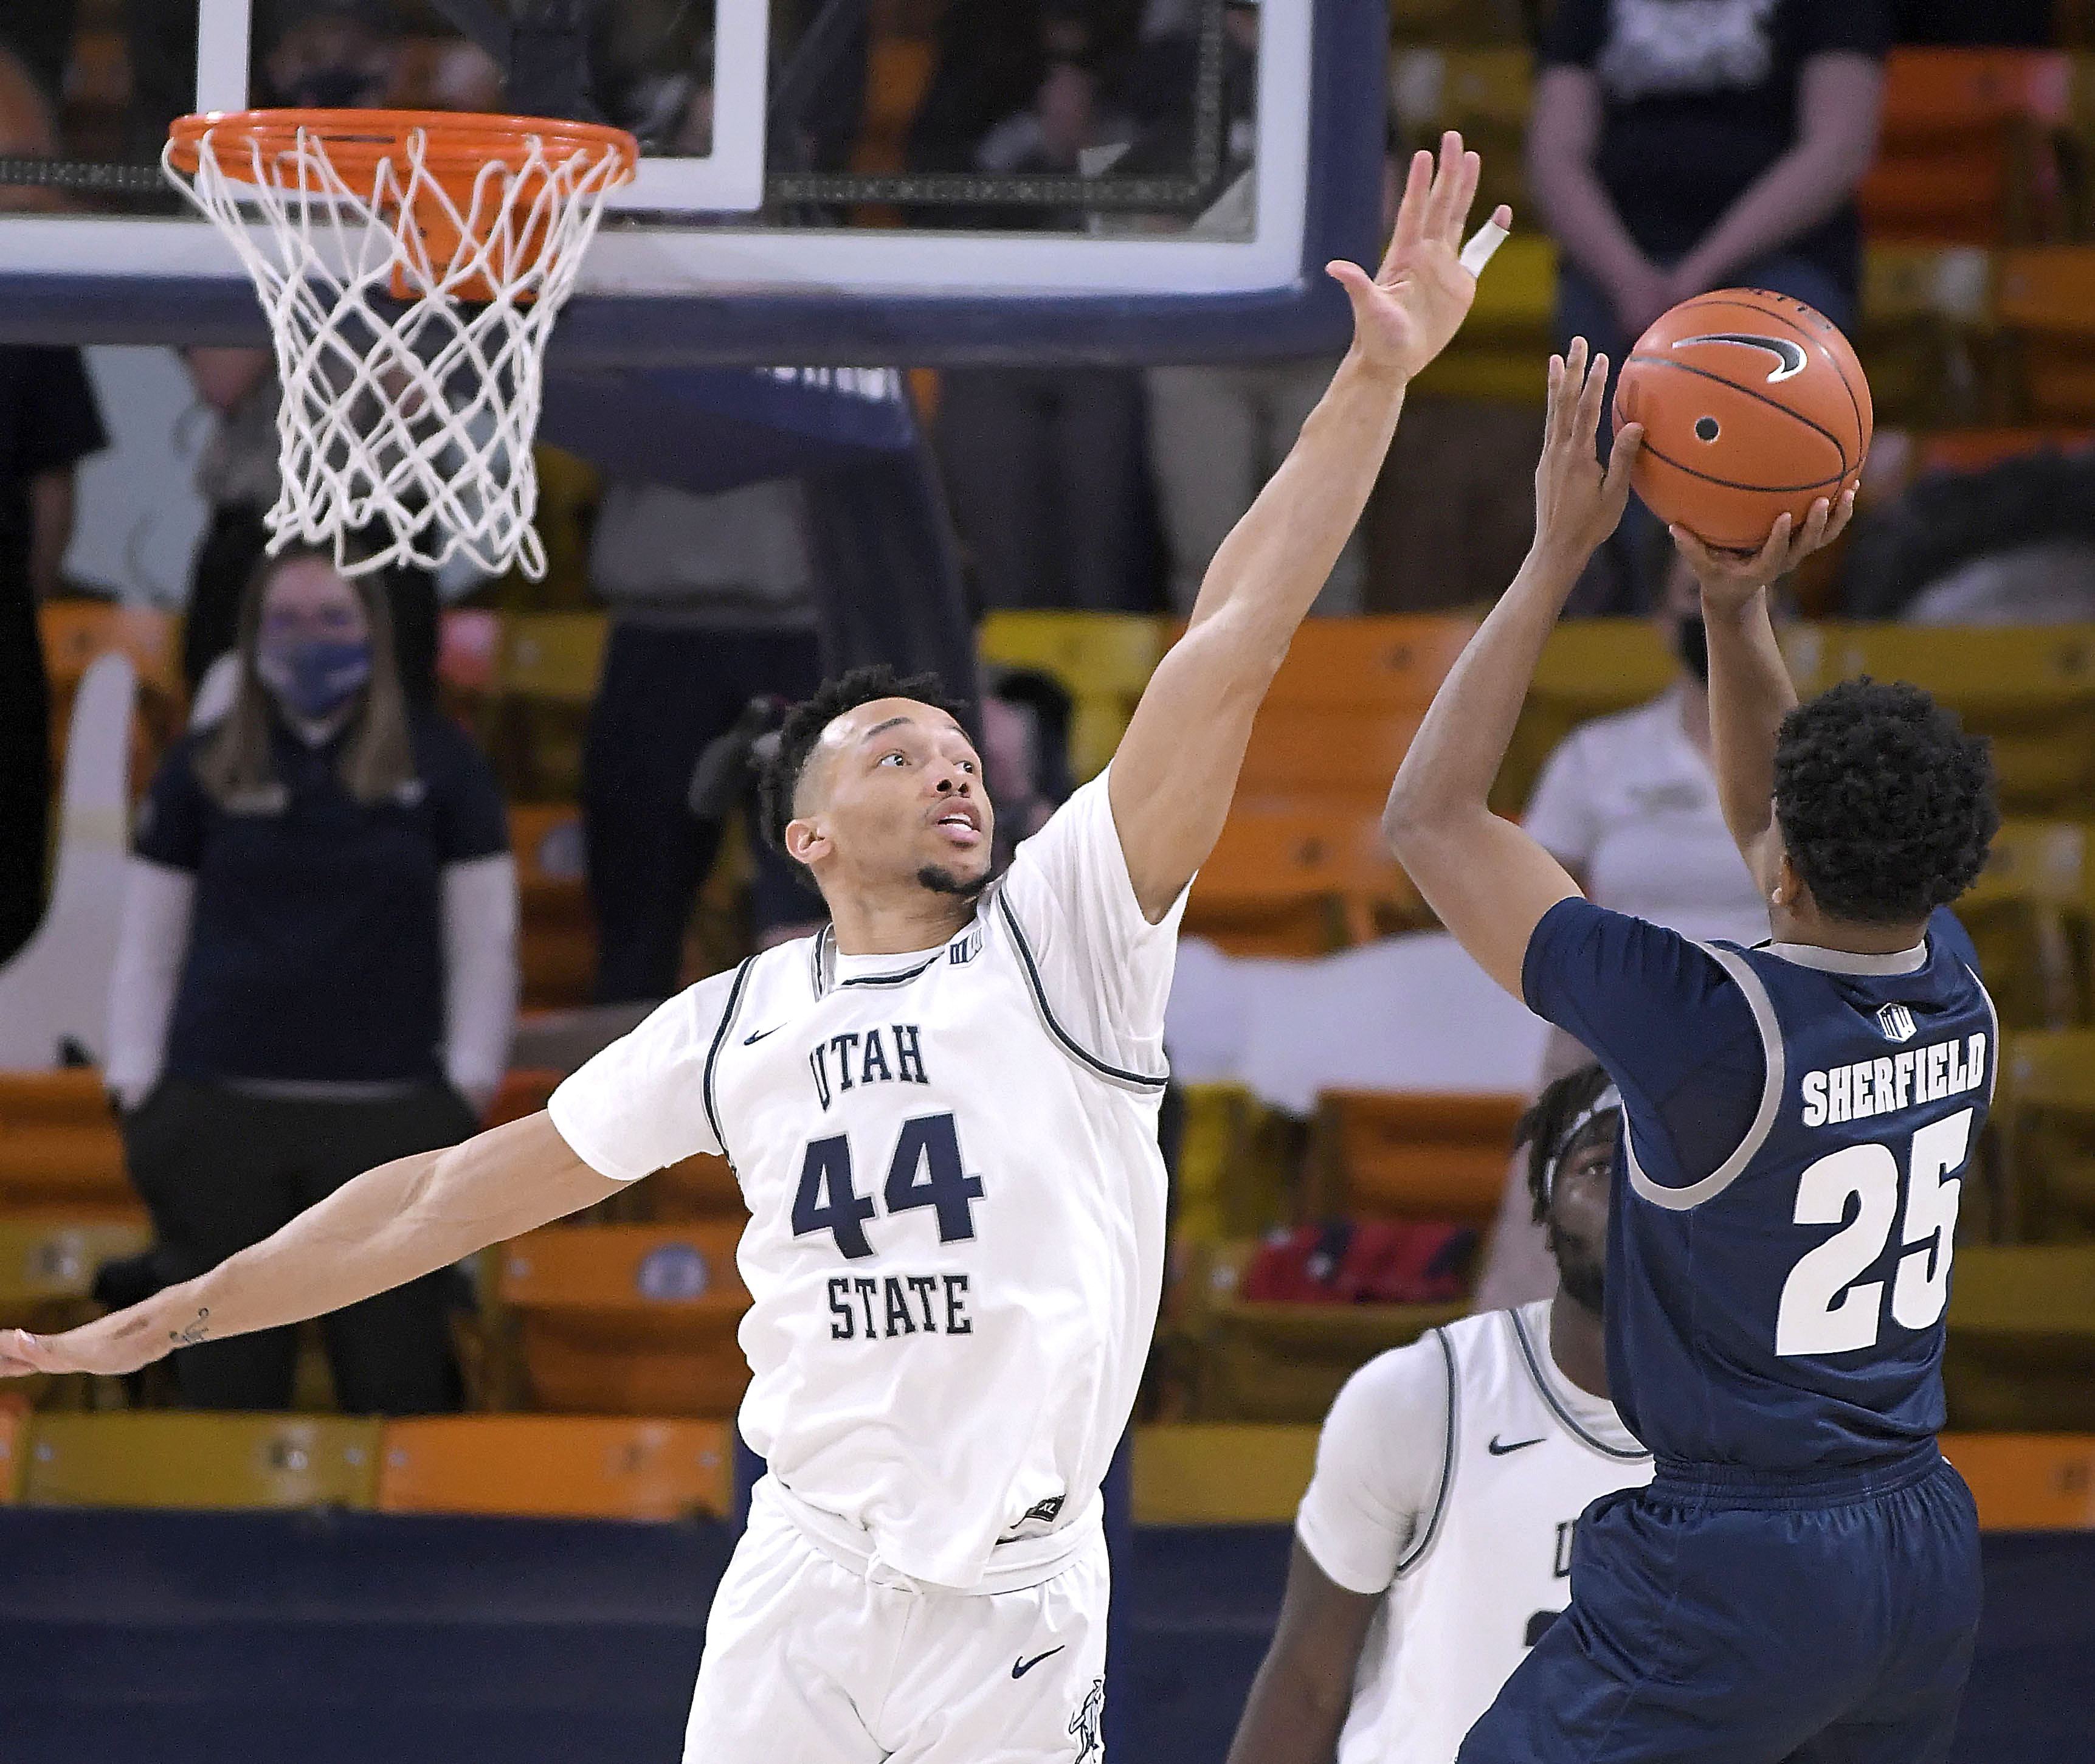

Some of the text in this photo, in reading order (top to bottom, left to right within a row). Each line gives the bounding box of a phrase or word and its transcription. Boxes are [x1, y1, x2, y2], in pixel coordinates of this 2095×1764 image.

[810, 1025, 929, 1112] UTAH
[1801, 1032, 1986, 1128] SHERFIELD
[791, 1112, 985, 1261] 44
[1775, 1106, 1973, 1357] 25
[827, 1275, 973, 1339] STATE
